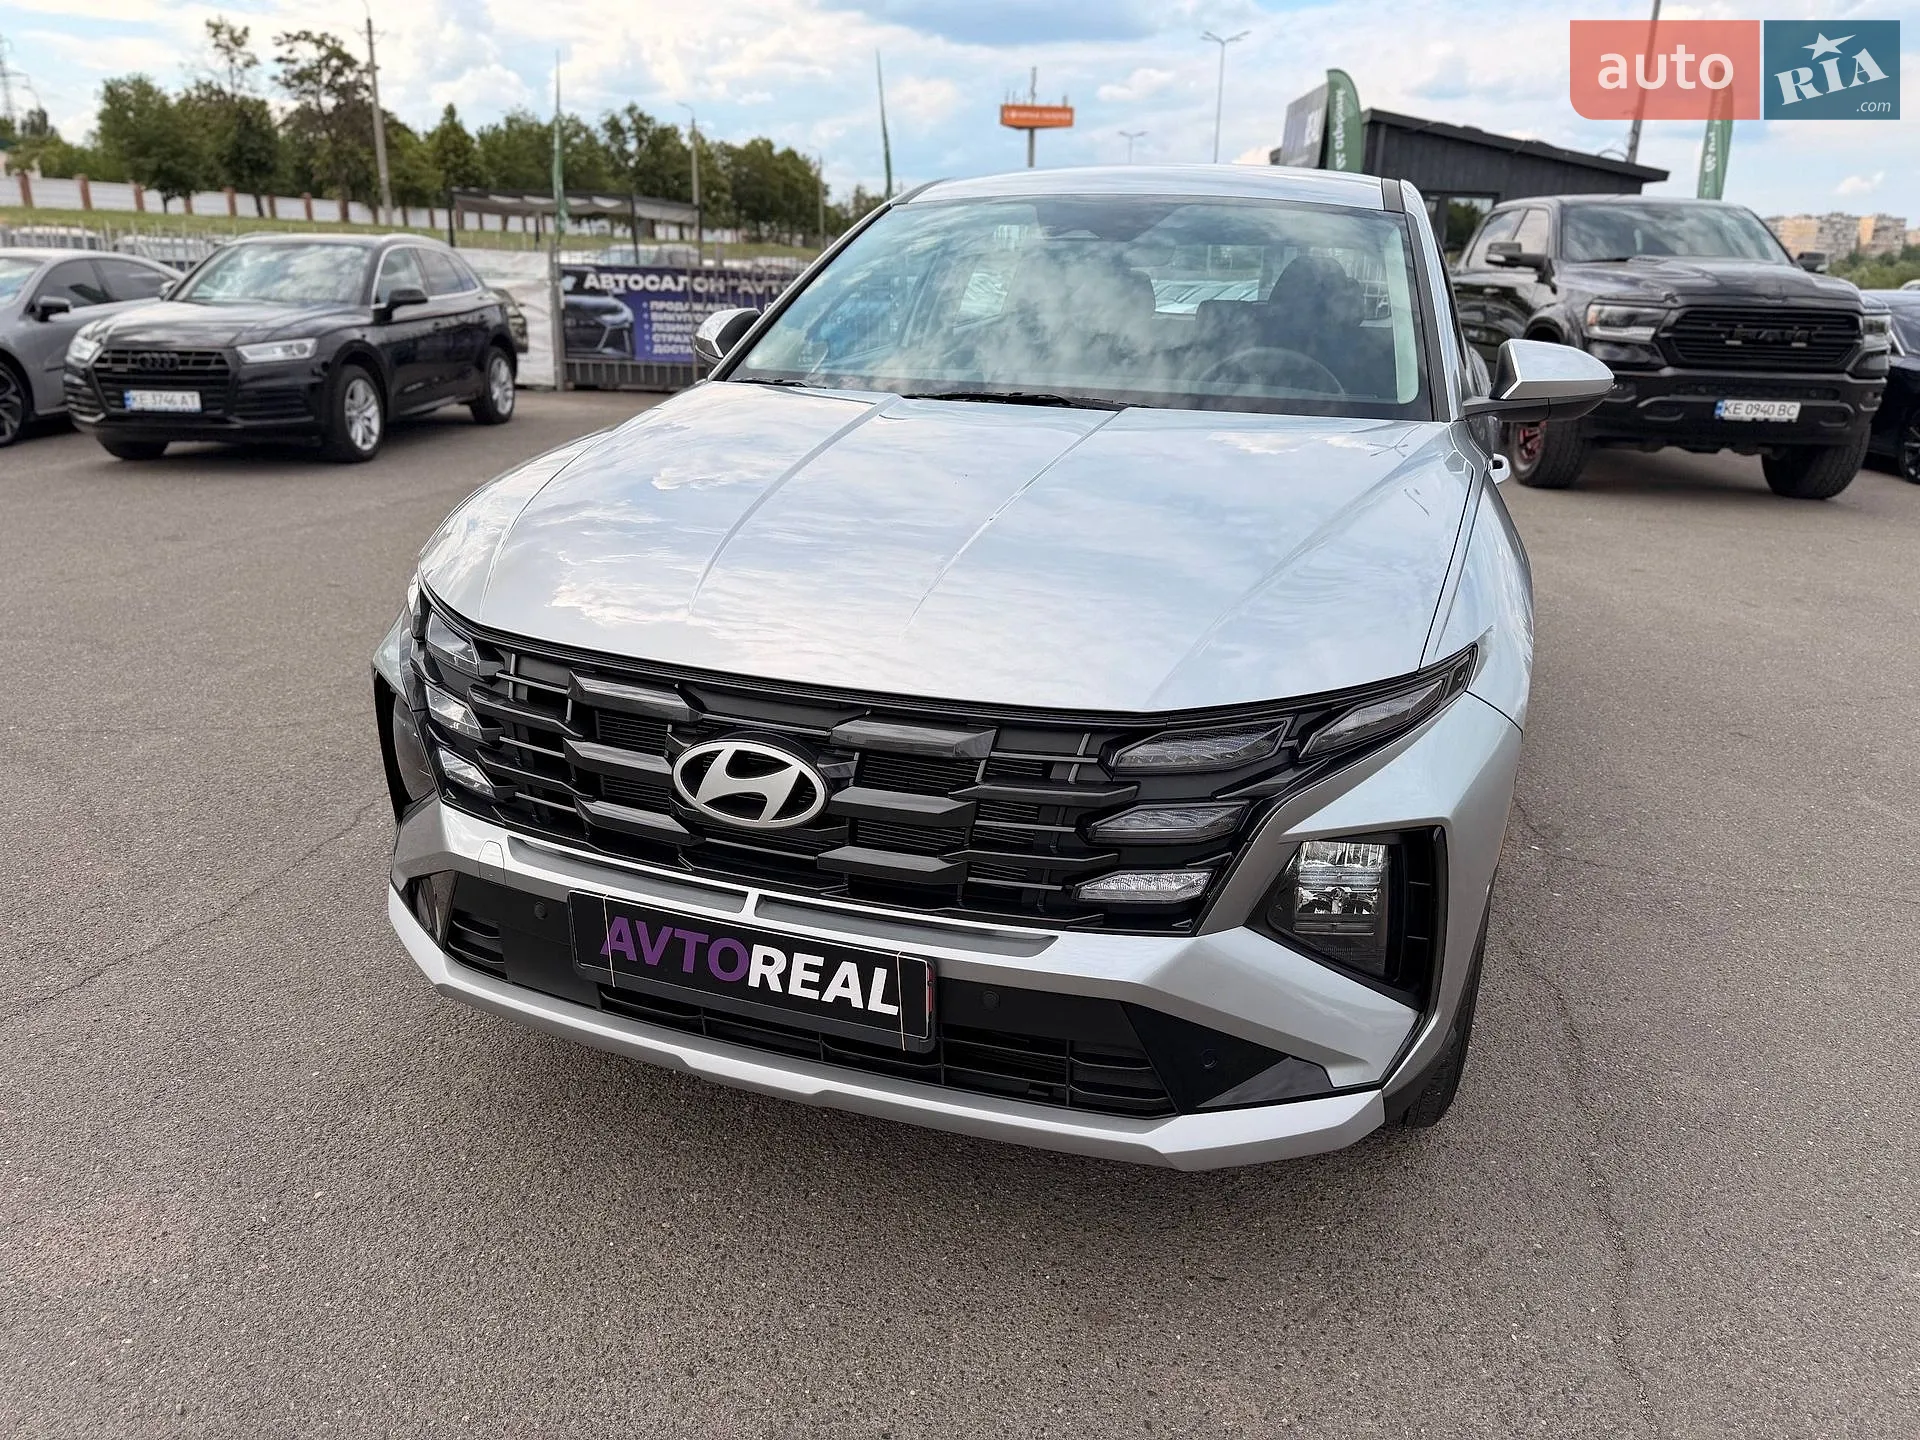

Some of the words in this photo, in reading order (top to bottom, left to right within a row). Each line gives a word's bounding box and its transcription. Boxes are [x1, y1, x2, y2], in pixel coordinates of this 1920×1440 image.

[583, 272, 725, 293] АВТОСАЛОН
[1723, 402, 1743, 415] KE
[1744, 403, 1776, 416] 0940
[1776, 404, 1797, 417] BC
[599, 915, 900, 1016] AVTOREAL
